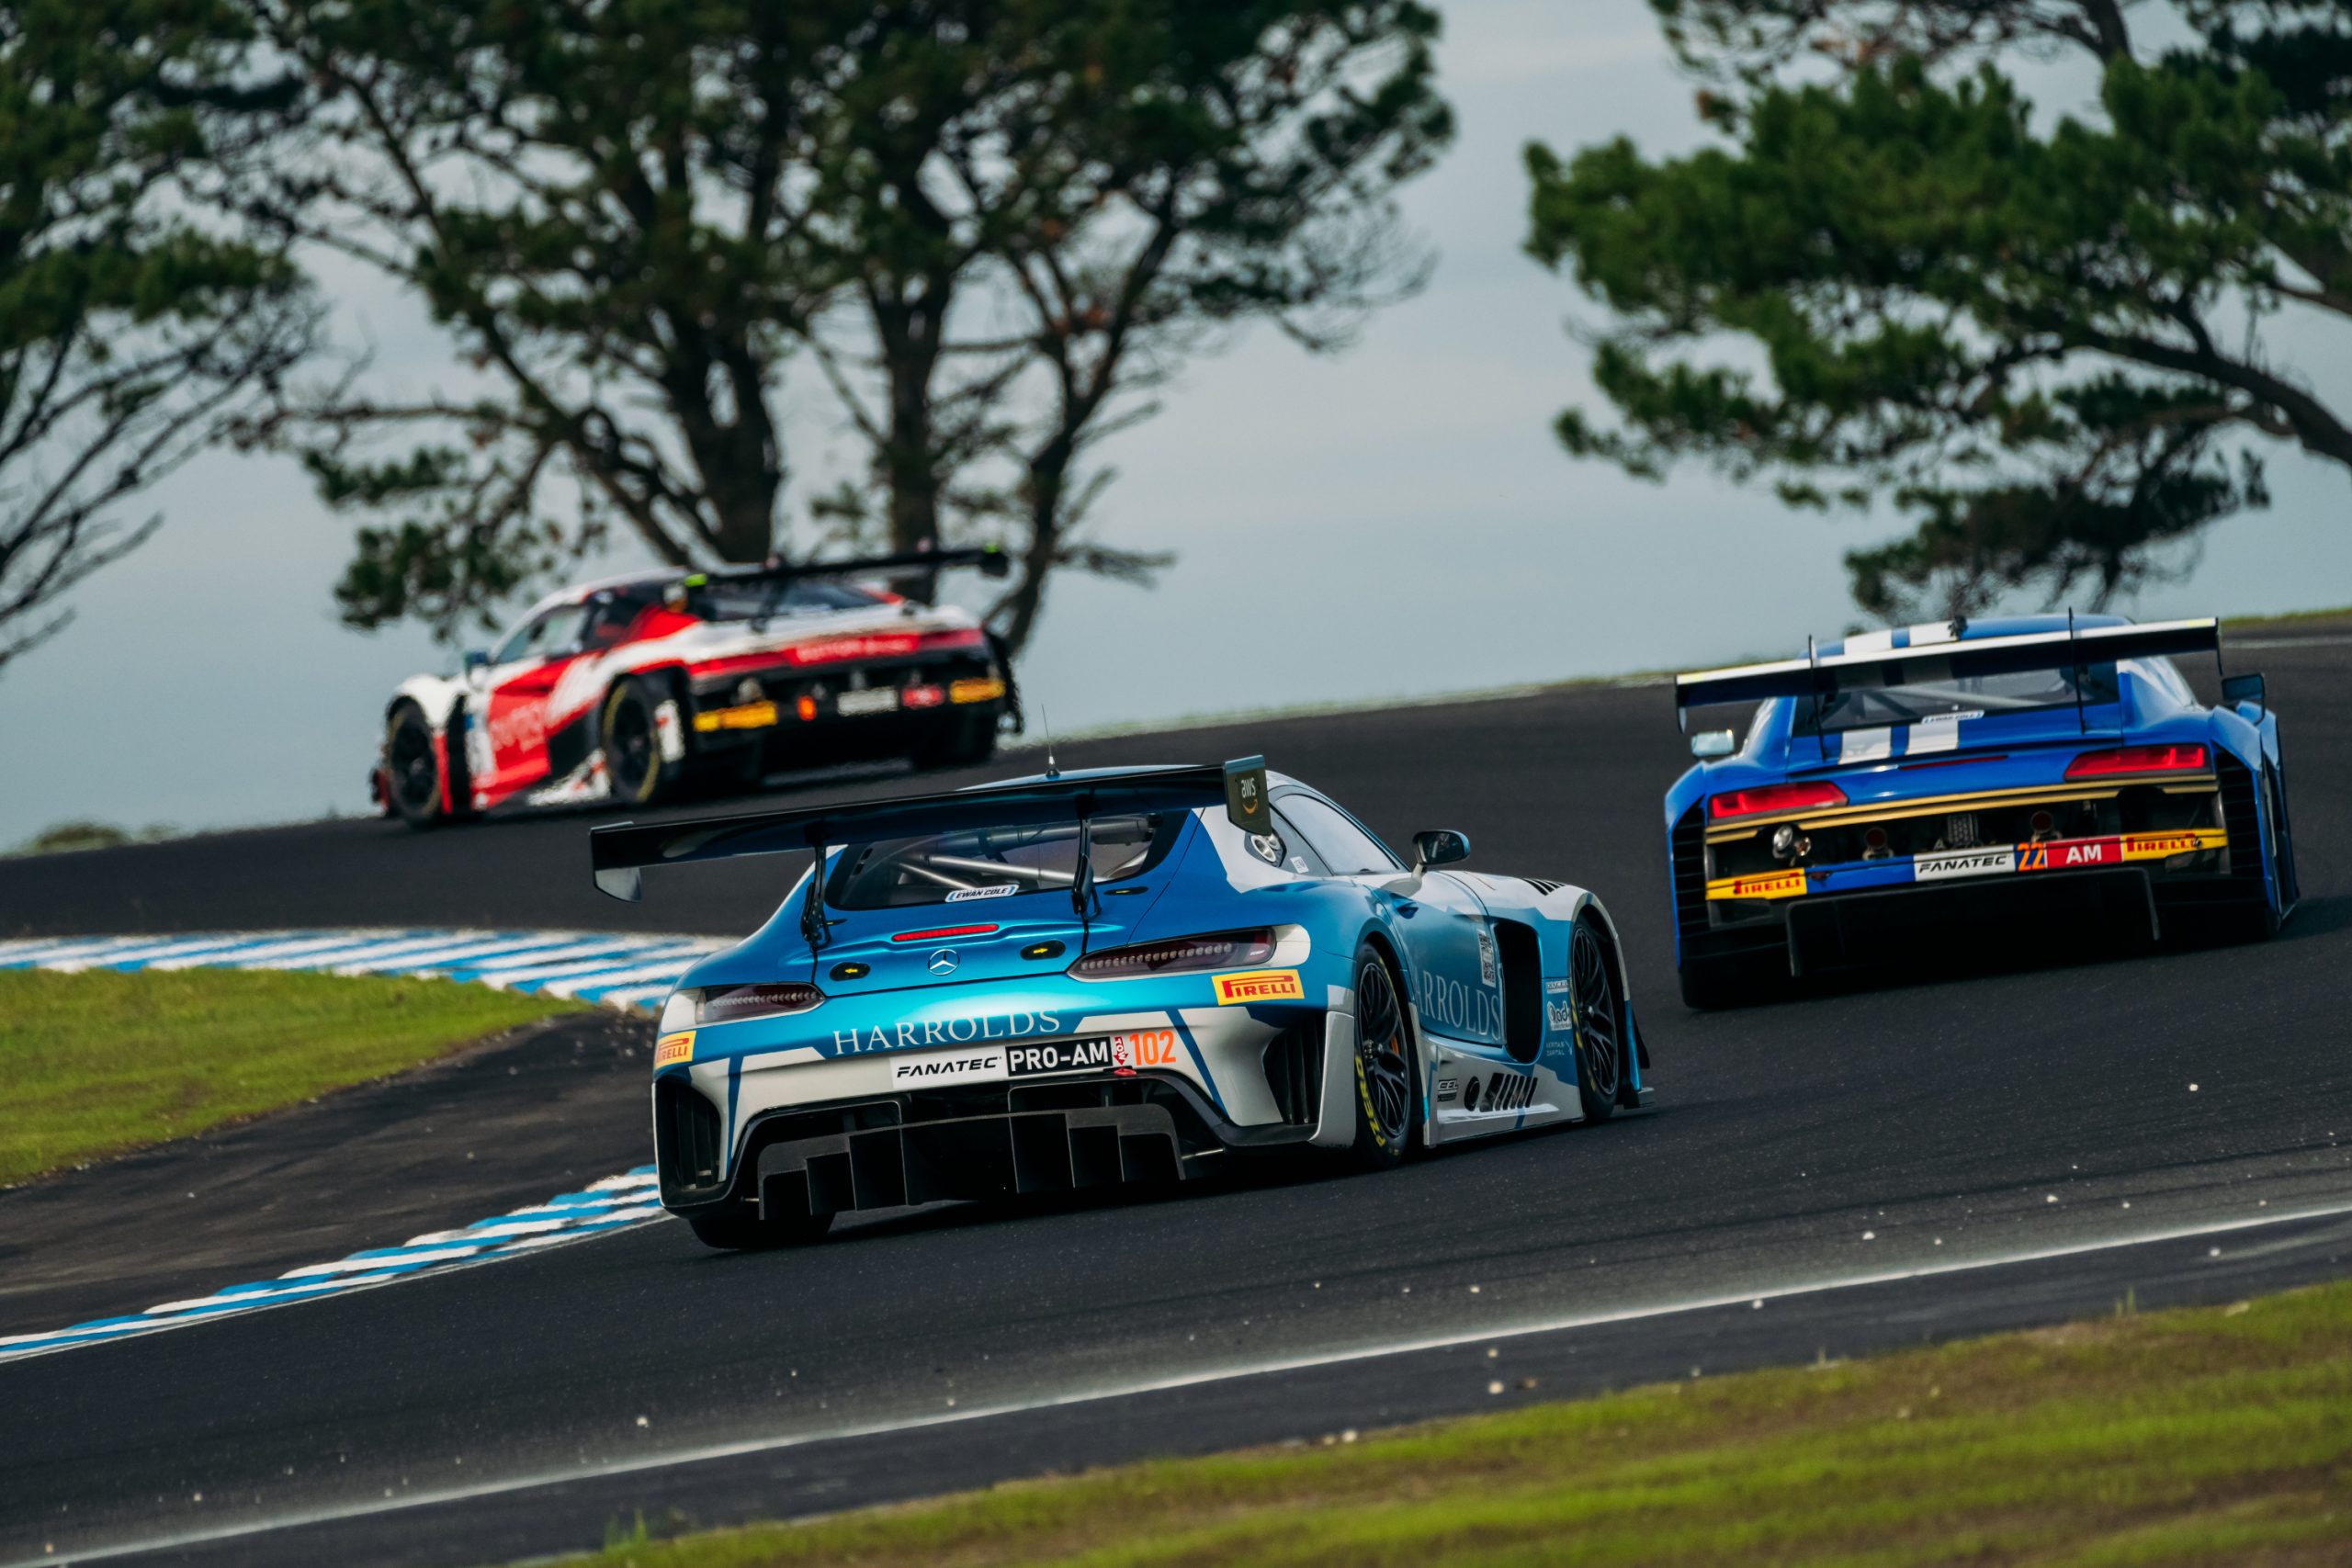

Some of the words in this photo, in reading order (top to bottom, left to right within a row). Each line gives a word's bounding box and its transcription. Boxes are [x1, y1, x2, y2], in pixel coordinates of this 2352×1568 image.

[1241, 777, 1256, 798] aws
[2065, 843, 2102, 864] AM
[2126, 833, 2197, 852] PIRELLI
[1919, 855, 2007, 874] FANATEC
[2017, 841, 2046, 872] 22
[956, 889, 983, 899] EWAN
[1733, 872, 1801, 895] PIRELLI
[1222, 975, 1296, 998] PIRELLI
[832, 1010, 1060, 1055] HARROLDS
[1009, 1041, 1110, 1072] PRO-AM
[1114, 1038, 1127, 1061] TOW
[1129, 1030, 1177, 1066] 102
[897, 1056, 999, 1077] FANATEC
